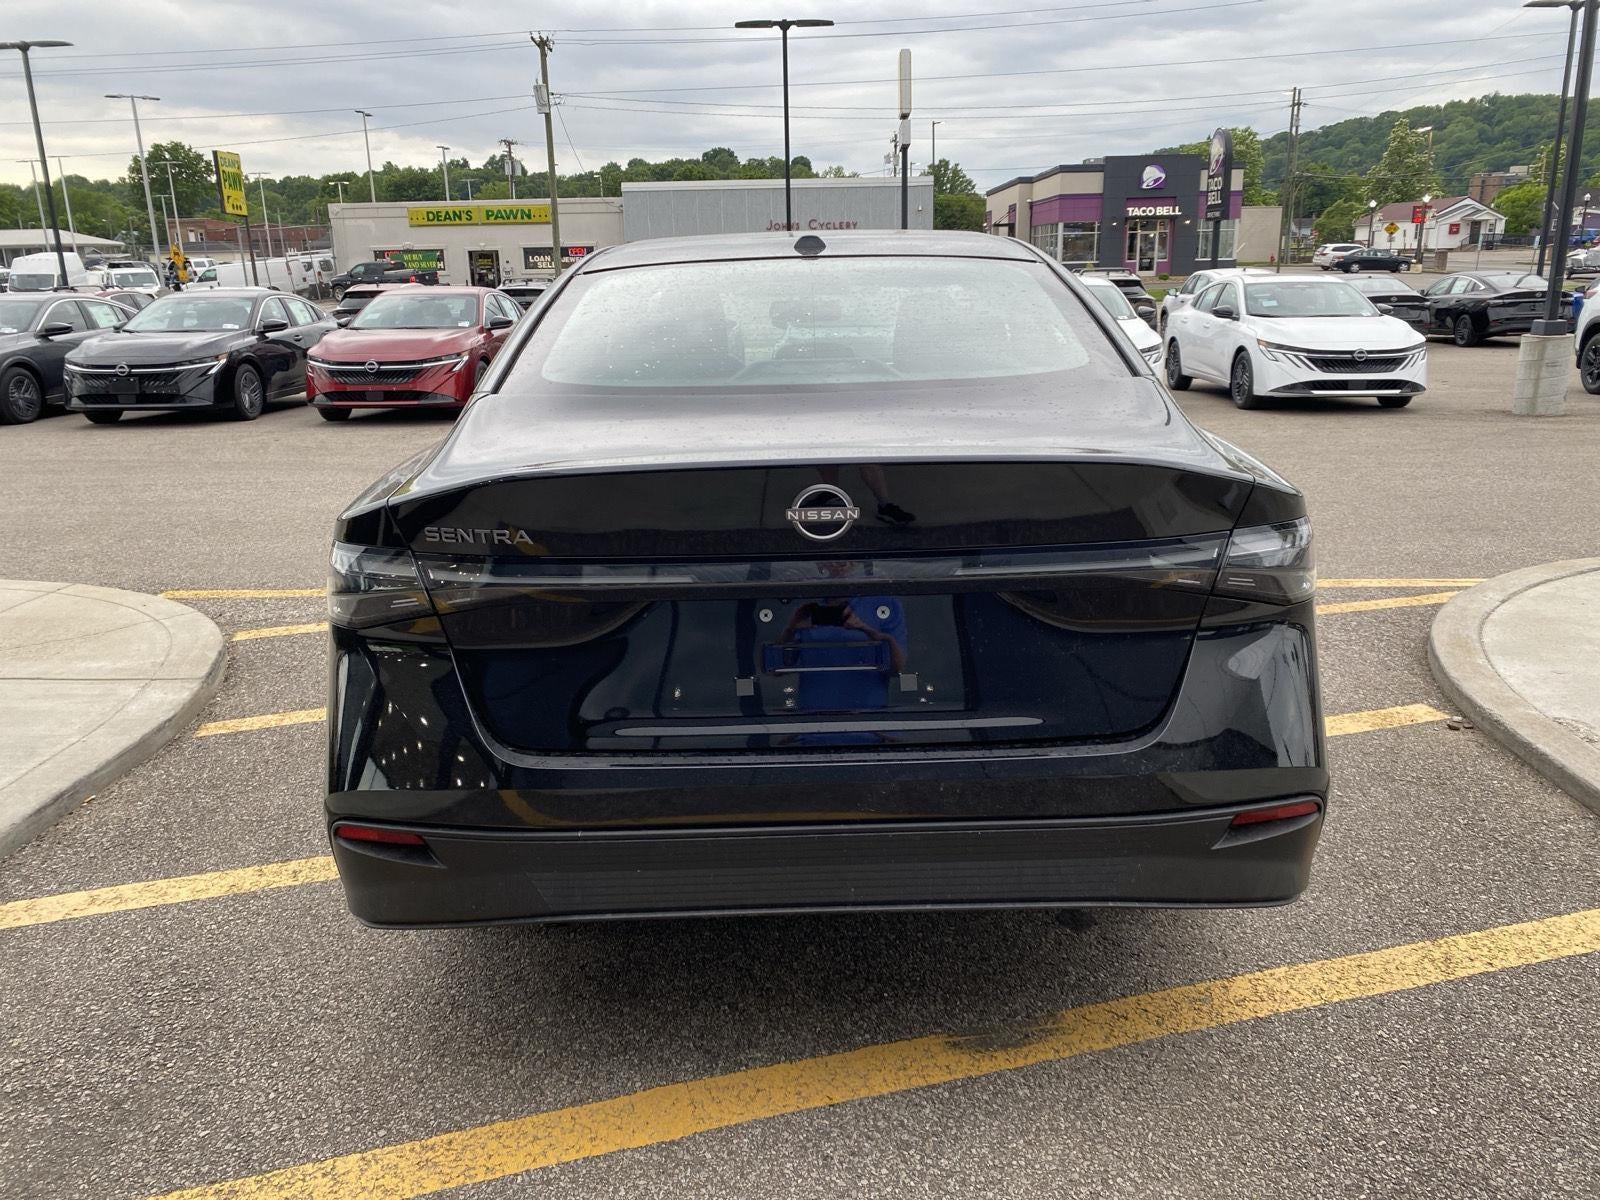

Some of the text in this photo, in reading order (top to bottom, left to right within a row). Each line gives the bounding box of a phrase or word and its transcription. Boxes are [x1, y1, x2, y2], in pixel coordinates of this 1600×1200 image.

[222, 169, 243, 192] PAWN
[1208, 177, 1222, 191] TACO
[1207, 191, 1221, 205] BELL
[485, 208, 532, 220] PAWN
[1127, 206, 1182, 216] TACO BELL
[787, 509, 858, 520] NISSAN
[424, 526, 534, 545] SENTRA
